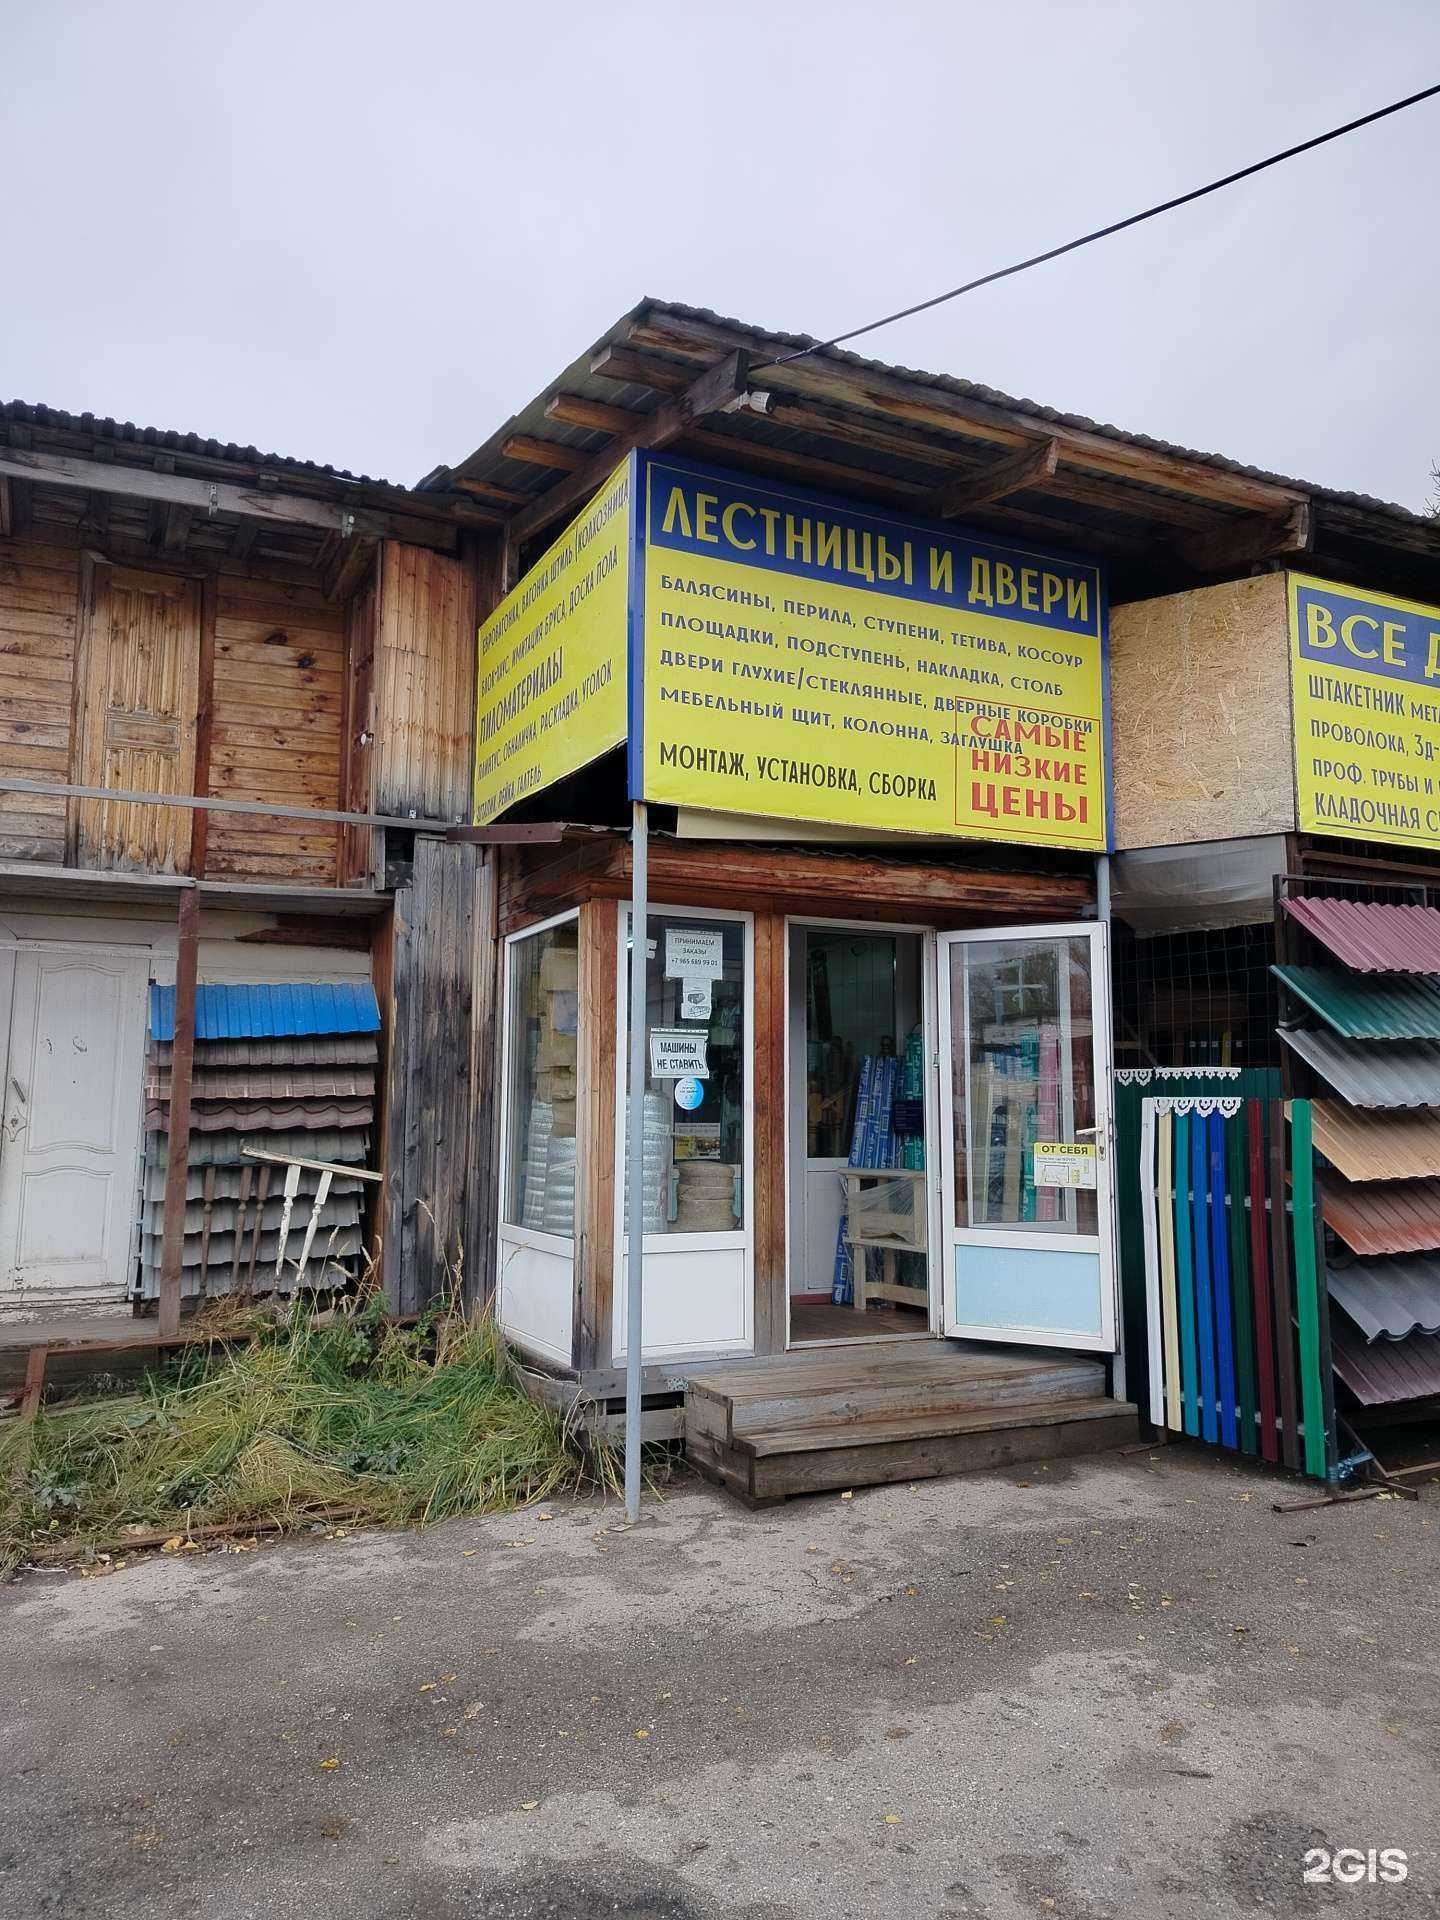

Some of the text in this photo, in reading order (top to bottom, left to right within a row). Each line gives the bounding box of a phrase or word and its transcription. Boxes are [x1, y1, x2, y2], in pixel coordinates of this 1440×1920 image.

[661, 486, 1089, 622] ЛЕСТНИЦЫ И ДВЕРИ
[522, 570, 549, 613] ВАГОНКА
[551, 545, 573, 582] ШТИЛЬ
[569, 569, 594, 616] ДОСКА
[596, 545, 618, 584] ПОЛА
[660, 574, 1083, 668] БАЛЯСИНЫ, ПЕРИЛА, СТУПЕНИ, ТЕТИВА, КОСОУР
[1306, 602, 1407, 667] ВСЕ
[660, 611, 1064, 697] ПЛОЩАДКИ, ПОДСТУПЕНЬ, НАКЛАДКА, СТОЛБ
[479, 645, 563, 746] ПИЛОМАТЕРИАЛЫ
[582, 658, 612, 703] УГОЛОК
[660, 649, 724, 673] ДВЕРИ
[933, 696, 1012, 720] ДВЕРНЫЕ
[1017, 708, 1093, 734] КОРОБКИ
[1308, 674, 1405, 717] ШТАКЕТНИК
[659, 686, 1024, 755] МЕБЕЛЬНЫЙ ЩИТ, КОЛОННА, ЗАГЛУШКА
[970, 714, 1088, 753] САМЫЕ
[1310, 719, 1409, 757] ПРОВОЛОКА,
[517, 763, 542, 797] ГАЛТЕЛЬ
[659, 741, 937, 802] МОНТАЖ, УСТАНОВКА, СБОРКА
[971, 750, 1088, 786] НИЗКИЕ
[1313, 758, 1367, 785] ПРОФ.
[1371, 768, 1419, 794] ТРУБЫ
[1424, 776, 1433, 795] И
[970, 782, 1089, 825] ЦЕНЫ
[1314, 791, 1421, 829] КЛАДОЧНАЯ
[674, 936, 716, 947] ПРИНИМАЕМ
[682, 947, 707, 956] ЗАКАЗЫ
[656, 1058, 704, 1071] НЕ СТАВИТЬ
[660, 1042, 697, 1055] МАШИНЫ
[1041, 1145, 1088, 1155] ОТ СЕБЯ
